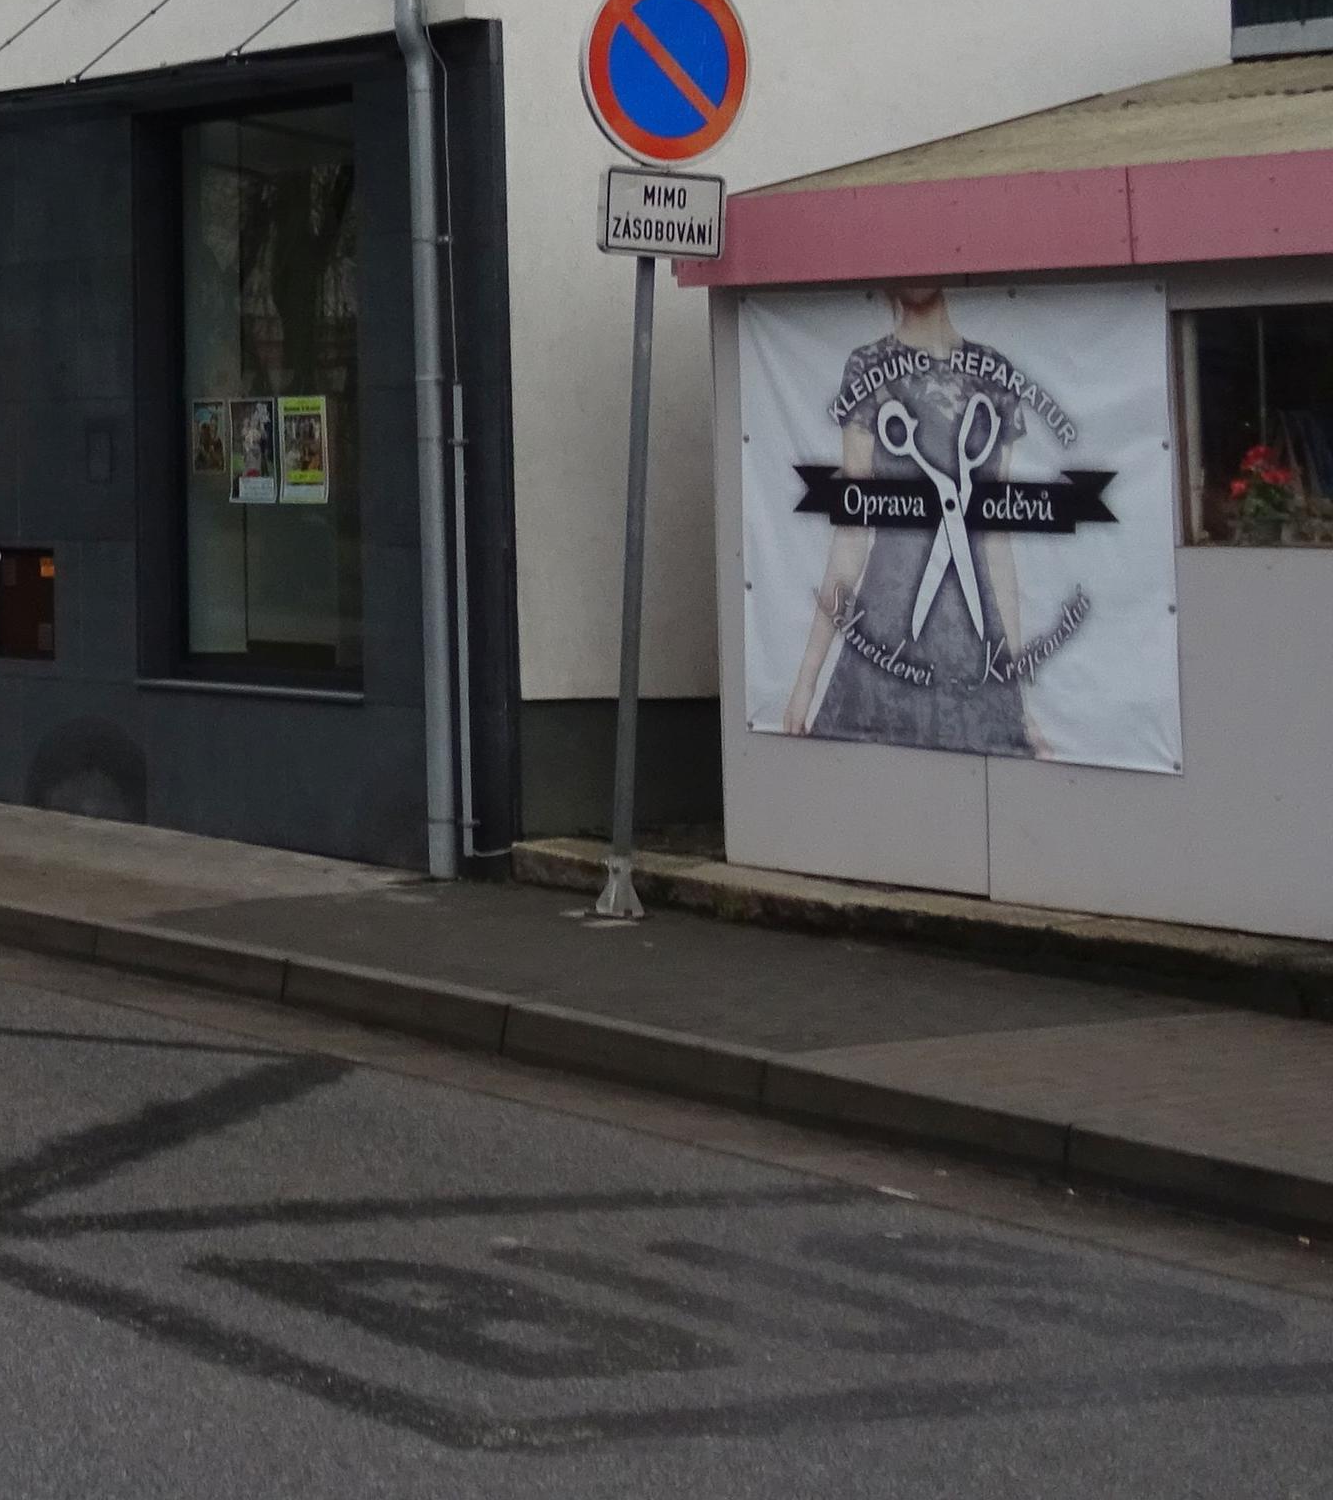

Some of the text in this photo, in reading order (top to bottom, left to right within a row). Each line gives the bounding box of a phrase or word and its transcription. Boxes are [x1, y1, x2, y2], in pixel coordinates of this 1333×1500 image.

[644, 185, 687, 209] MIMO
[612, 211, 713, 246] ZÁSOBOVÁNÍ
[828, 351, 1078, 446] KLEIDUNG REPARATUR
[844, 484, 1055, 525] Oprava oděvů
[813, 586, 933, 686] Schneiderei
